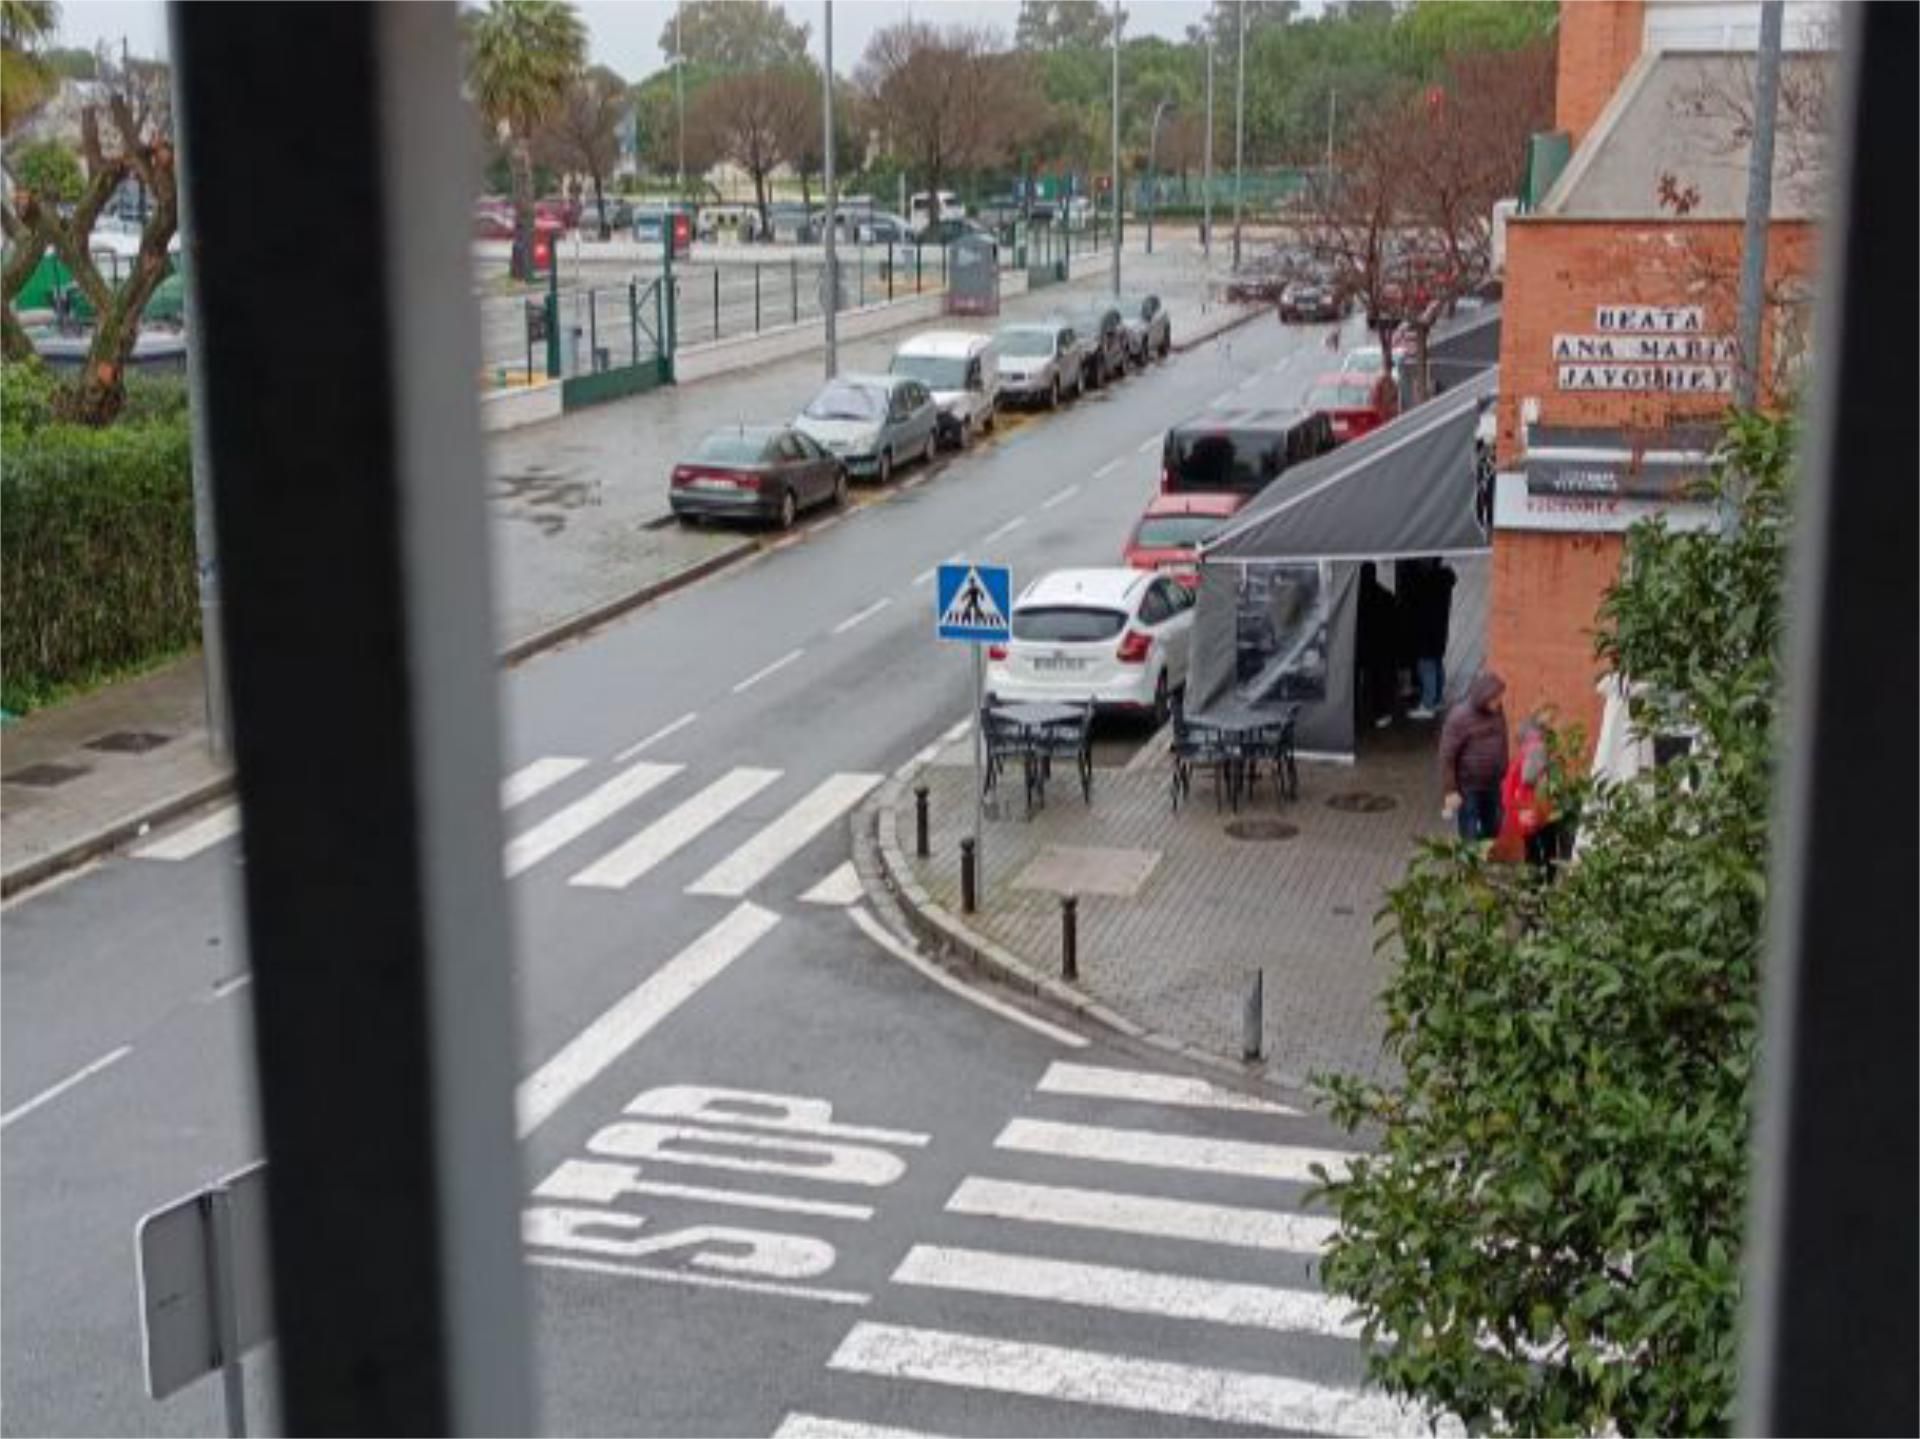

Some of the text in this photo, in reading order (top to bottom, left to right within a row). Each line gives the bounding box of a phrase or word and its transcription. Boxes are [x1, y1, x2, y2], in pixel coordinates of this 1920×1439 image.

[1599, 310, 1700, 329] BEATA
[1557, 338, 1614, 357] ANA
[522, 1083, 933, 1278] STOP
